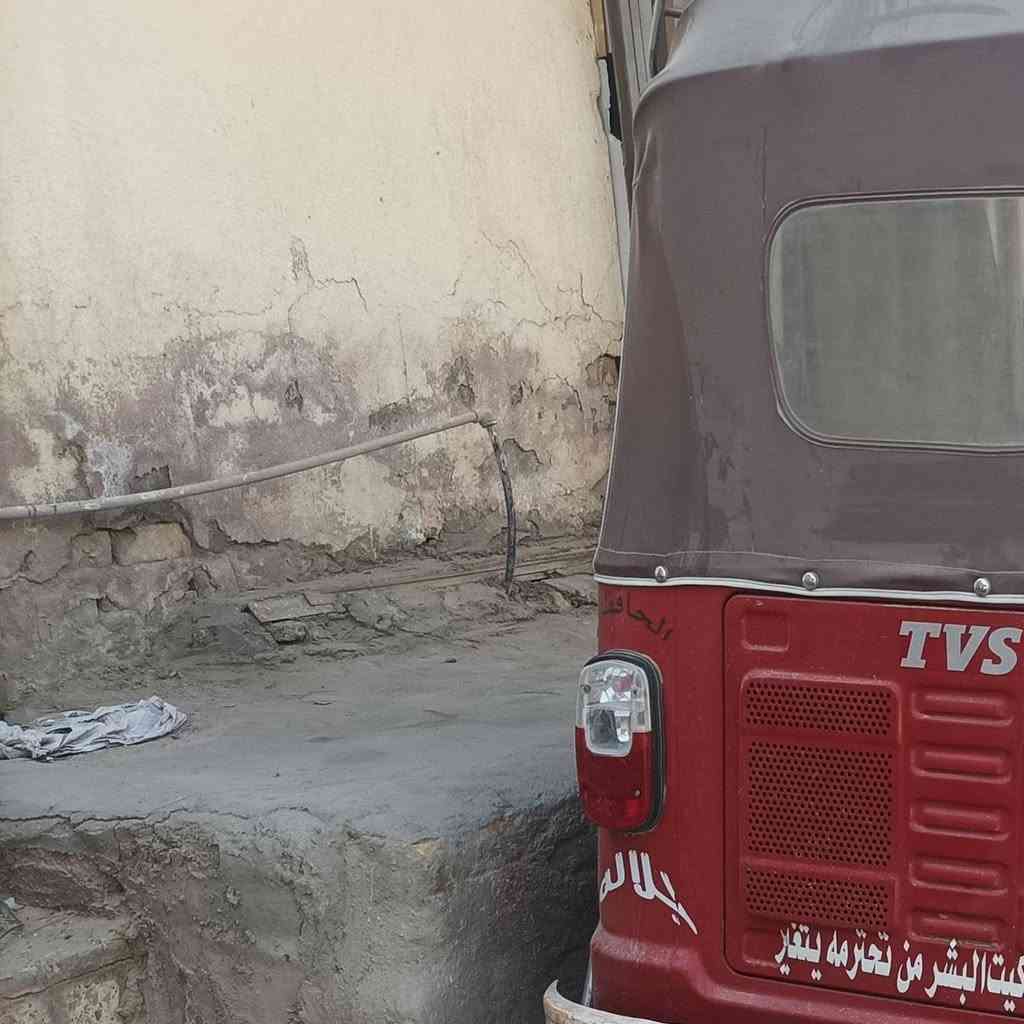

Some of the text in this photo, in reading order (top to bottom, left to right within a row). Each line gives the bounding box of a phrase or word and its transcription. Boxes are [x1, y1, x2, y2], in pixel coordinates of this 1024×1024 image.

[899, 621, 1023, 675] TVS
[775, 923, 822, 981] يتغير
[826, 929, 892, 980] تحترمه
[897, 940, 923, 993] من
[924, 938, 986, 1006] البشر
